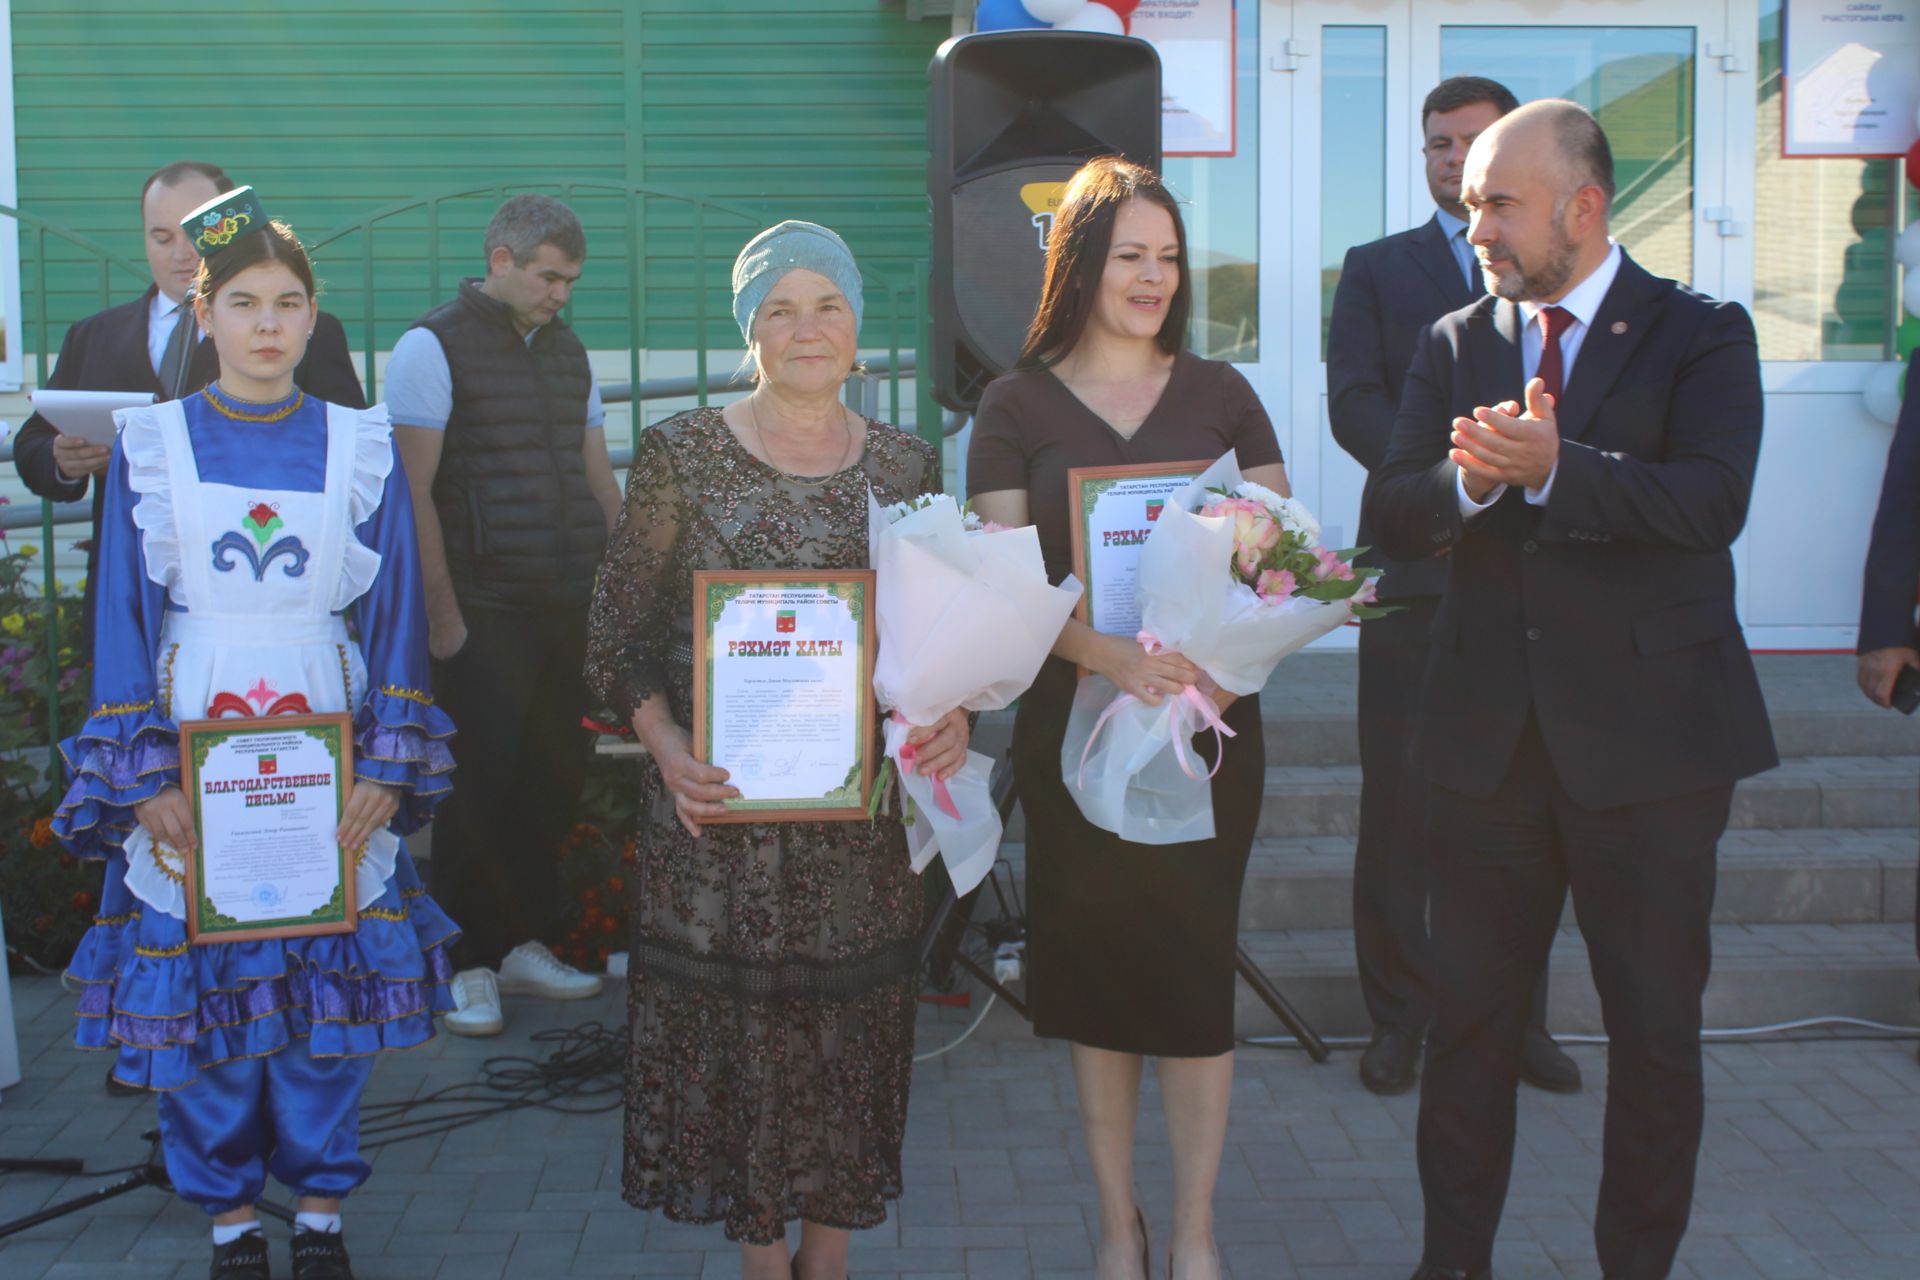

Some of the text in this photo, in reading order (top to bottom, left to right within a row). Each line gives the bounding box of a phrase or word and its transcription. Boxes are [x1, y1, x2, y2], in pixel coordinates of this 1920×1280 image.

[1103, 529, 1152, 547] РӘХМ
[796, 640, 843, 656] ХАТЫ
[205, 773, 331, 794] БЛАГОДАРСТВЕННОЕ
[245, 792, 296, 808] ПИСЬМО
